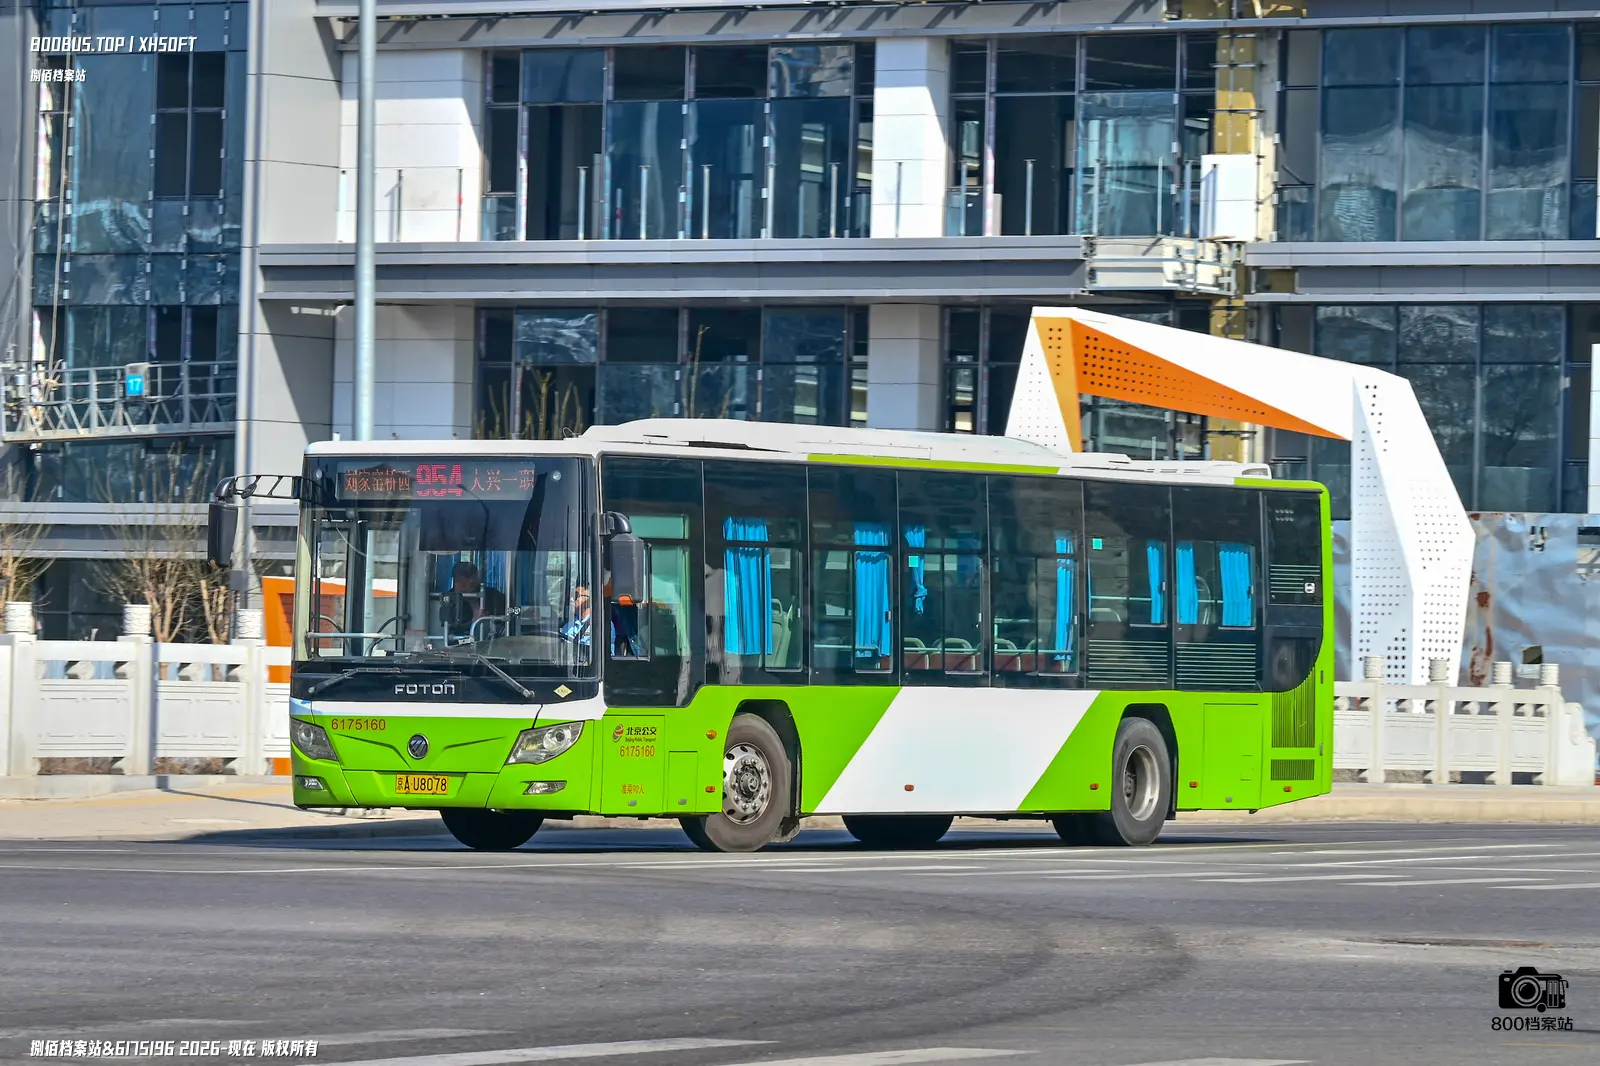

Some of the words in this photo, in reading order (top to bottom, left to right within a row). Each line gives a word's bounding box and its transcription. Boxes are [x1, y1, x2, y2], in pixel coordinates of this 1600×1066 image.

[127, 378, 142, 391] 17
[416, 464, 463, 497] 954
[394, 680, 455, 695] FOTON
[331, 719, 386, 731] 6175160
[626, 726, 657, 736] 北京公交
[620, 745, 655, 757] 6175160
